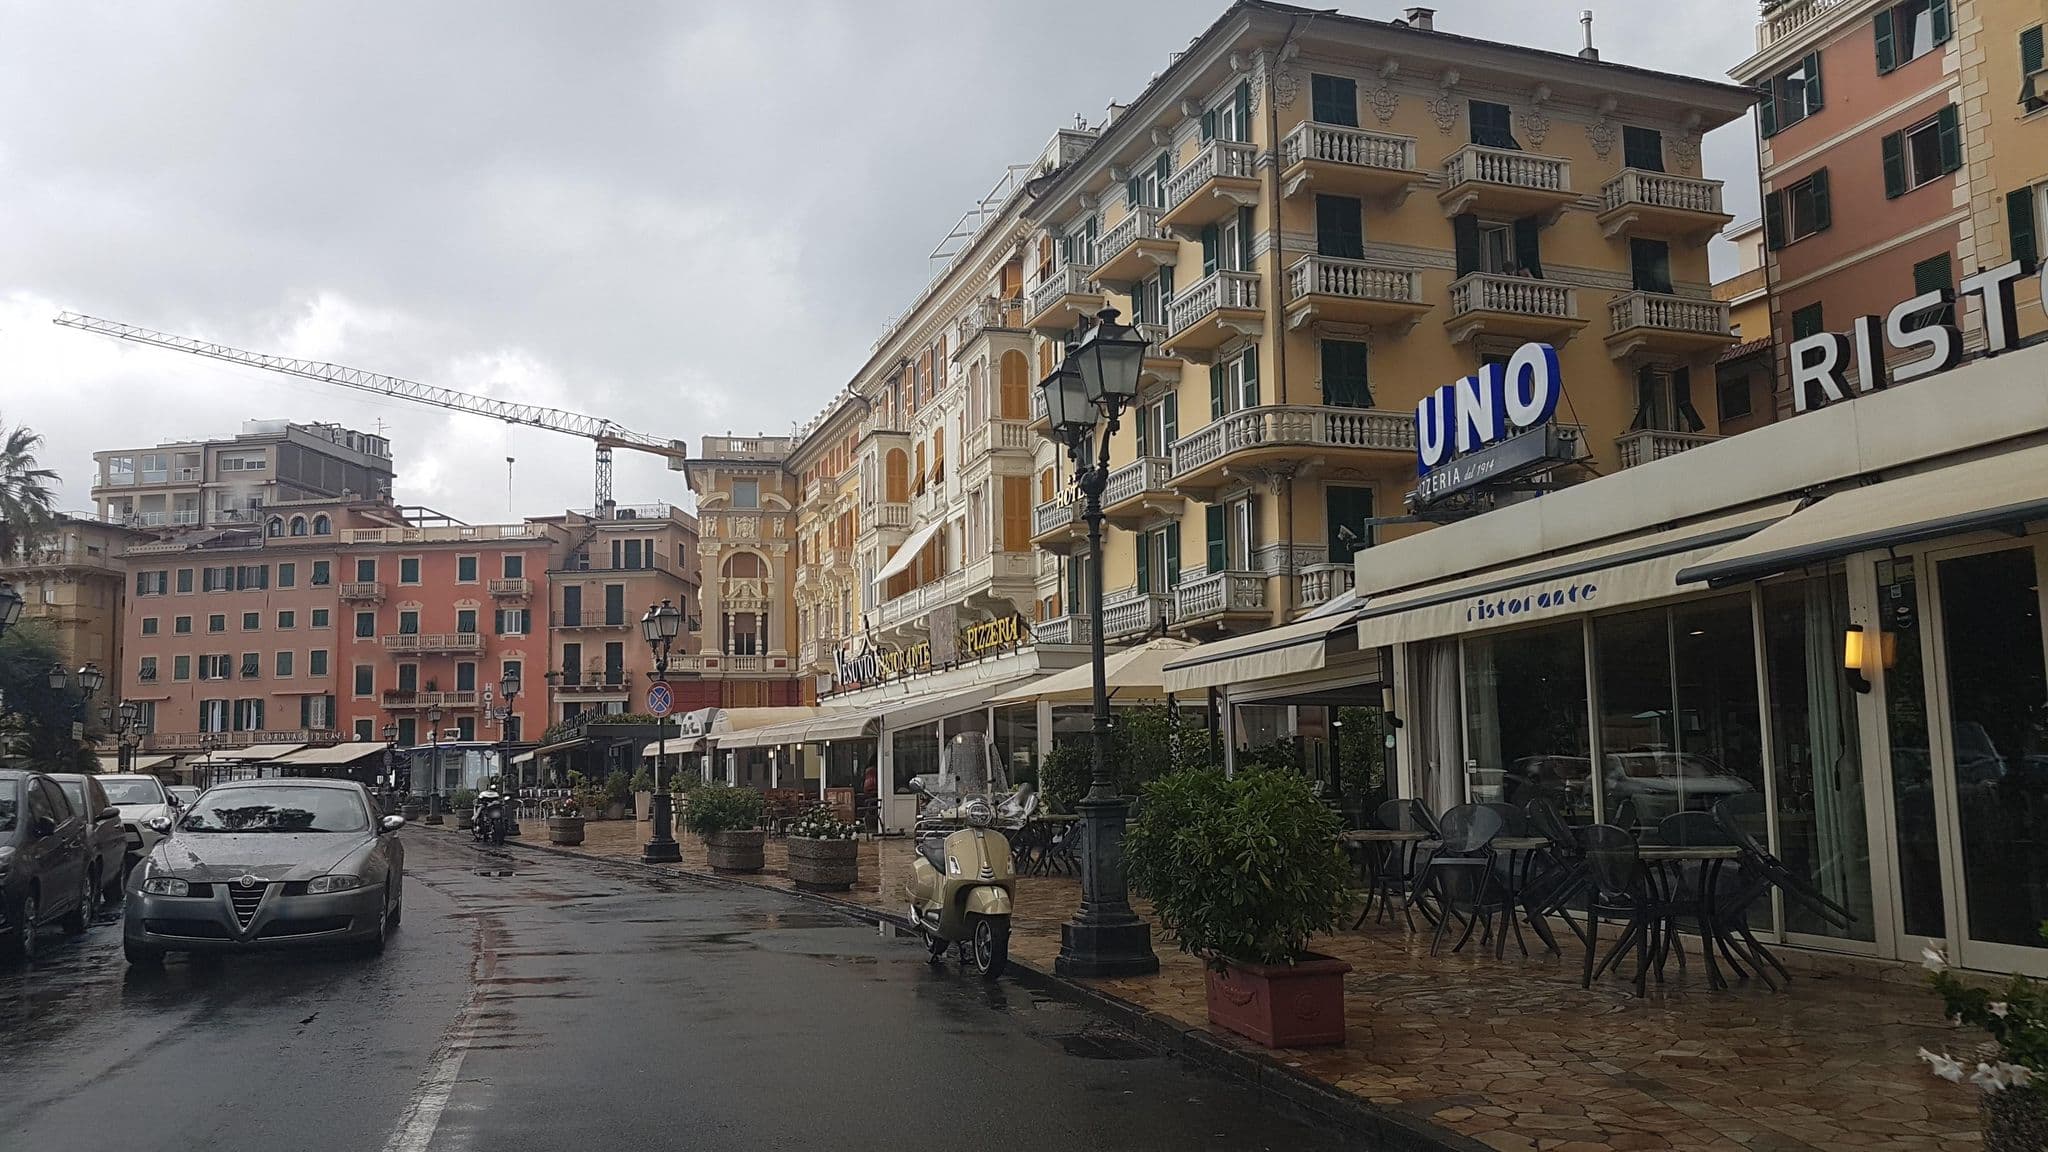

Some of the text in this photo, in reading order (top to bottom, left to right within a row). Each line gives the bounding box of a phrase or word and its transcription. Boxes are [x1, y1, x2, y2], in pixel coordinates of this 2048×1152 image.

[1790, 256, 2048, 412] RIST
[1417, 342, 1552, 467] UNO
[1056, 482, 1087, 509] HOTE
[1418, 467, 1461, 498] IZZERIA
[1477, 458, 1495, 476] 1914
[1466, 583, 1598, 622] ristorante
[966, 613, 1019, 652] PIZZERIA
[484, 682, 493, 728] HOTEL
[261, 732, 320, 741] CARAVAGIO
